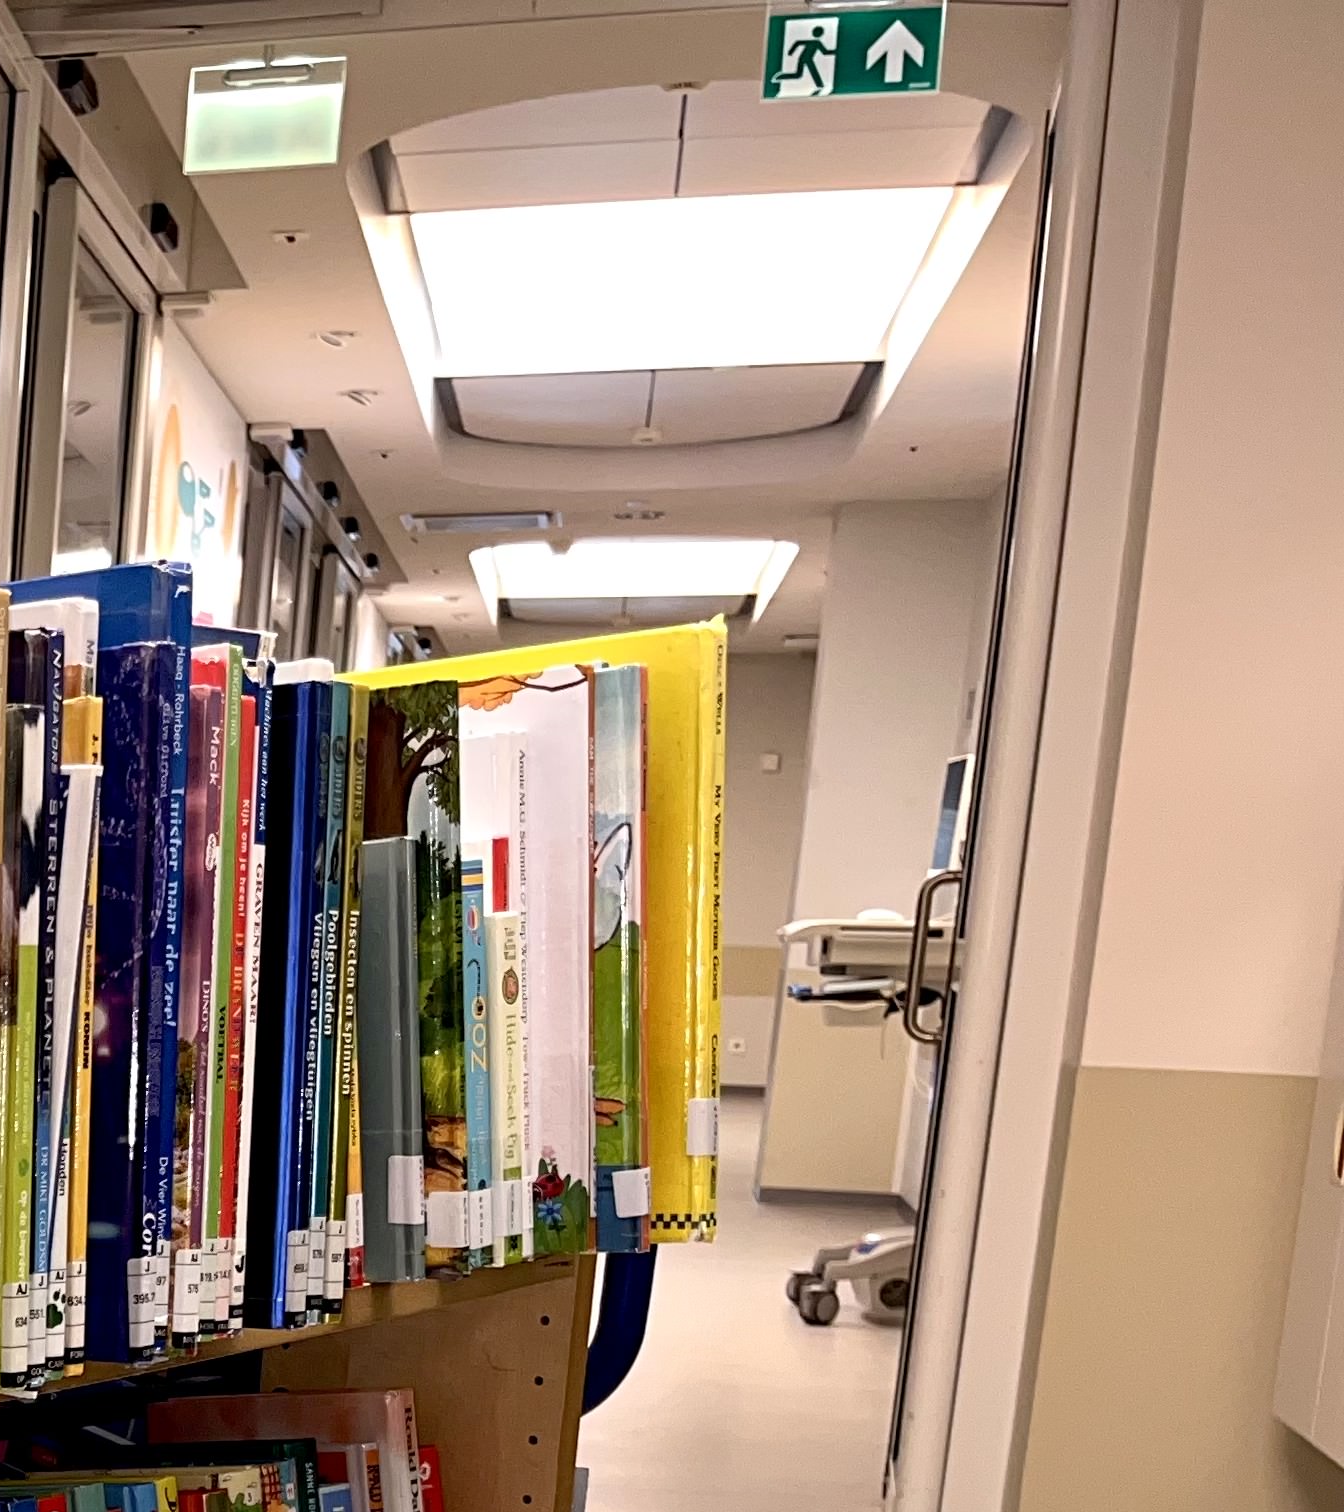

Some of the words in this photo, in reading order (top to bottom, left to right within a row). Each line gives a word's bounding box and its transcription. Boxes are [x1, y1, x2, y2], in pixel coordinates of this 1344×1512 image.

[49, 648, 64, 776] NAVIGATORS
[173, 692, 183, 755] Rohrbeck
[209, 726, 220, 786] Mack
[168, 785, 184, 873] Luister
[240, 799, 250, 829] Kijk
[240, 832, 247, 854] om
[45, 798, 60, 934] STERREN
[239, 857, 247, 871] je
[167, 879, 178, 937] naar
[237, 874, 245, 917] heen!
[165, 943, 178, 972] de
[322, 909, 339, 1036] Poolgebieden
[345, 909, 360, 980] Insecten
[163, 981, 177, 1027] zee!
[200, 980, 211, 1033] DINO'S
[343, 985, 355, 1016] en
[40, 977, 54, 1117] PLANETEN
[341, 1020, 354, 1096] spinnen
[57, 1138, 69, 1197] Honden
[405, 1406, 418, 1473] Roald
